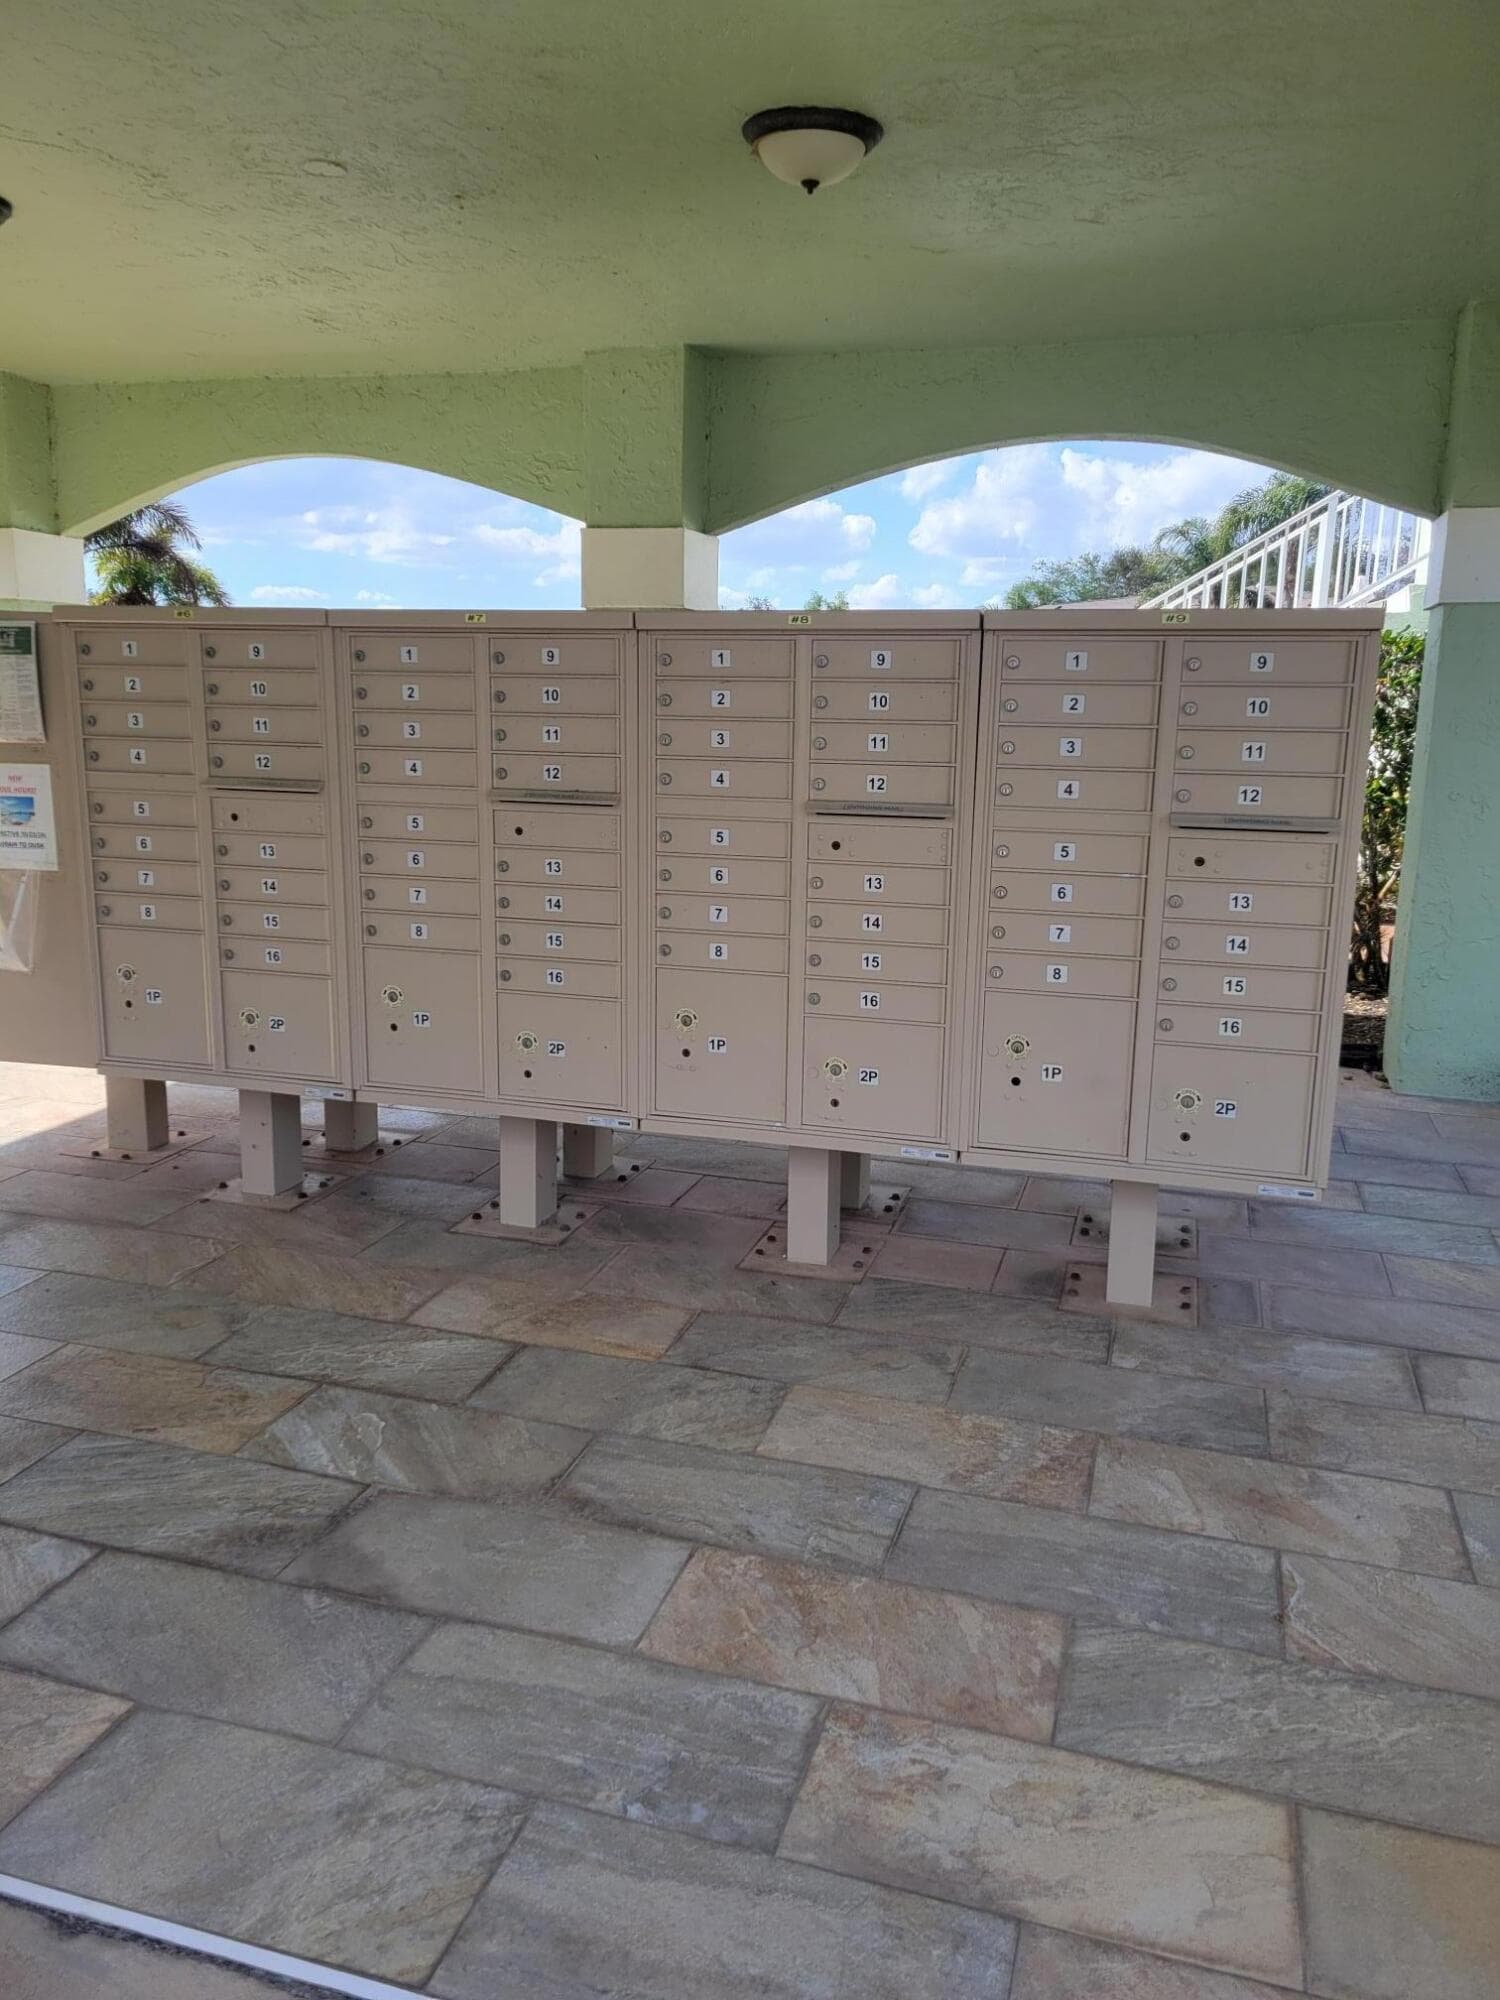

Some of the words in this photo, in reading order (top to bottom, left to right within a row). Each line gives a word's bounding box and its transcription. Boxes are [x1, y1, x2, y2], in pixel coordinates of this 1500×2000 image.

[467, 613, 484, 622] #7
[791, 615, 809, 624] #8
[1166, 614, 1187, 623] #9
[126, 643, 132, 654] 1
[252, 645, 260, 658] 9
[406, 648, 412, 661] 1
[546, 650, 555, 663] 9
[717, 652, 724, 665] 1
[876, 653, 886, 666] 9
[1072, 654, 1080, 668] 1
[1257, 655, 1267, 670] 9
[128, 679, 137, 691] 2
[252, 682, 266, 695] 10
[407, 686, 415, 699] 2
[544, 688, 559, 702] 10
[717, 692, 725, 705] 2
[871, 695, 888, 708] 10
[1069, 697, 1079, 711] 2
[1249, 700, 1268, 714] 10
[132, 714, 139, 727] 3
[255, 719, 268, 731] 11
[408, 724, 416, 737] 3
[545, 728, 559, 741] 11
[716, 732, 725, 745] 3
[870, 736, 886, 750] 11
[1066, 740, 1076, 754] 3
[1245, 744, 1263, 759] 11
[134, 751, 142, 762] 4
[256, 756, 271, 768] 12
[409, 762, 418, 774] 4
[545, 767, 560, 780] 12
[716, 772, 725, 785] 4
[869, 777, 885, 791] 12
[1063, 783, 1073, 796] 4
[1240, 789, 1260, 803] 12
[138, 803, 145, 815] 5
[412, 817, 419, 829] 5
[140, 838, 148, 849] 6
[716, 831, 724, 844] 5
[261, 845, 275, 857] 13
[1060, 845, 1070, 858] 5
[412, 853, 420, 866] 6
[546, 861, 561, 873] 13
[142, 872, 150, 884] 7
[715, 869, 724, 882] 6
[263, 880, 277, 892] 14
[866, 877, 882, 890] 13
[414, 889, 422, 901] 7
[1057, 886, 1067, 900] 6
[547, 898, 562, 910] 14
[1231, 895, 1250, 909] 13
[144, 906, 152, 918] 8
[715, 908, 723, 920] 7
[265, 916, 279, 927] 15
[864, 916, 881, 929] 14
[415, 925, 423, 937] 8
[1055, 927, 1065, 940] 7
[547, 934, 562, 947] 15
[1228, 938, 1247, 952] 14
[266, 950, 281, 962] 16
[714, 945, 723, 958] 8
[863, 956, 880, 968] 15
[548, 971, 563, 983] 16
[1052, 967, 1062, 980] 8
[1225, 979, 1244, 993] 15
[146, 991, 161, 1001] 1P
[862, 994, 878, 1007] 16
[270, 1018, 285, 1030] 2P
[414, 1014, 430, 1025] 1P
[1221, 1020, 1240, 1034] 16
[549, 1042, 565, 1055] 2P
[709, 1039, 726, 1051] 1P
[860, 1070, 878, 1083] 2P
[1043, 1066, 1062, 1079] 1P
[1215, 1102, 1236, 1115] 2P
